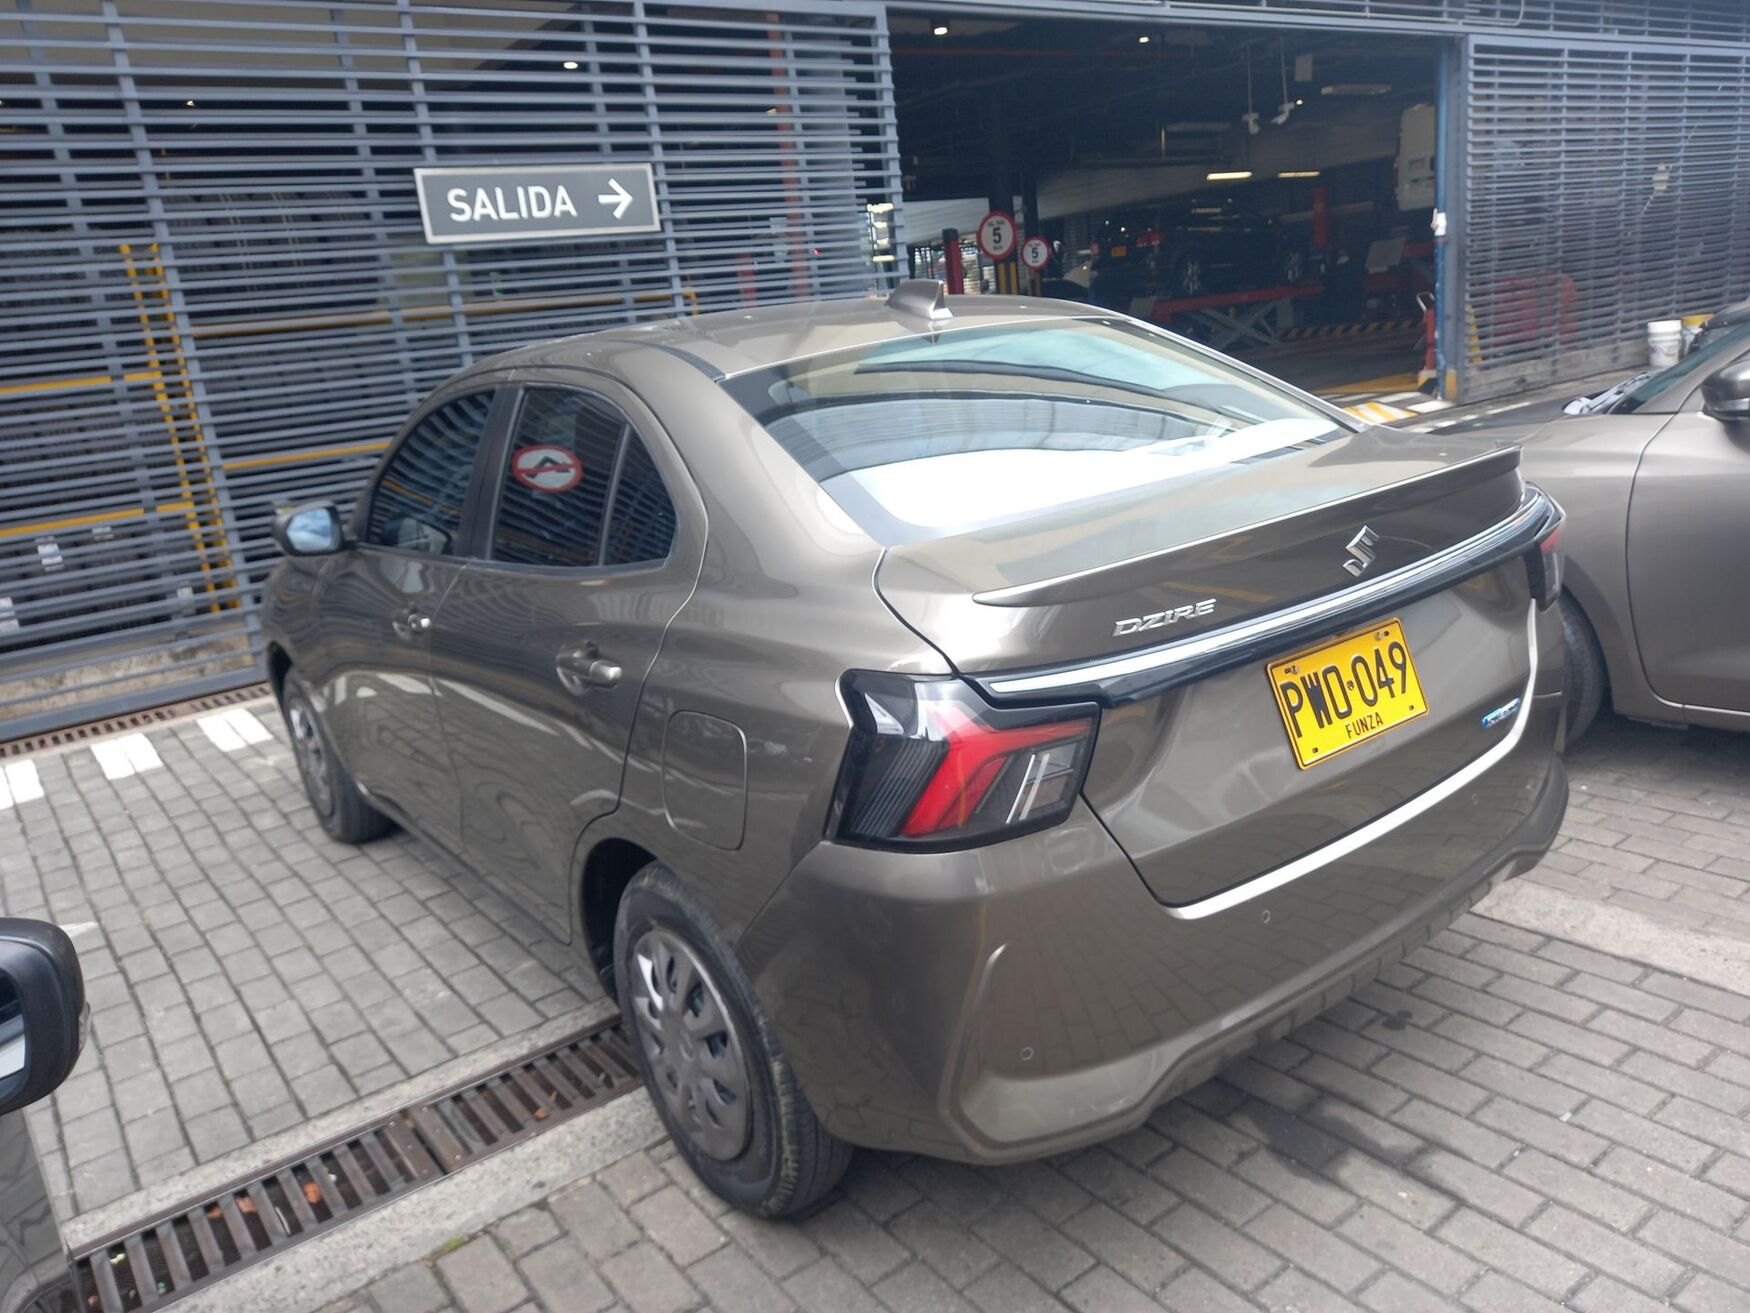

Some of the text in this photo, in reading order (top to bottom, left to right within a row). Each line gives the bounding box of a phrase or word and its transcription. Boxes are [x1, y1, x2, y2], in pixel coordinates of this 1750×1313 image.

[446, 184, 578, 223] SALIDA
[992, 226, 1002, 244] 5
[1031, 246, 1039, 259] 5
[1112, 598, 1217, 638] DZIRE
[1345, 711, 1385, 740] FUNZA
